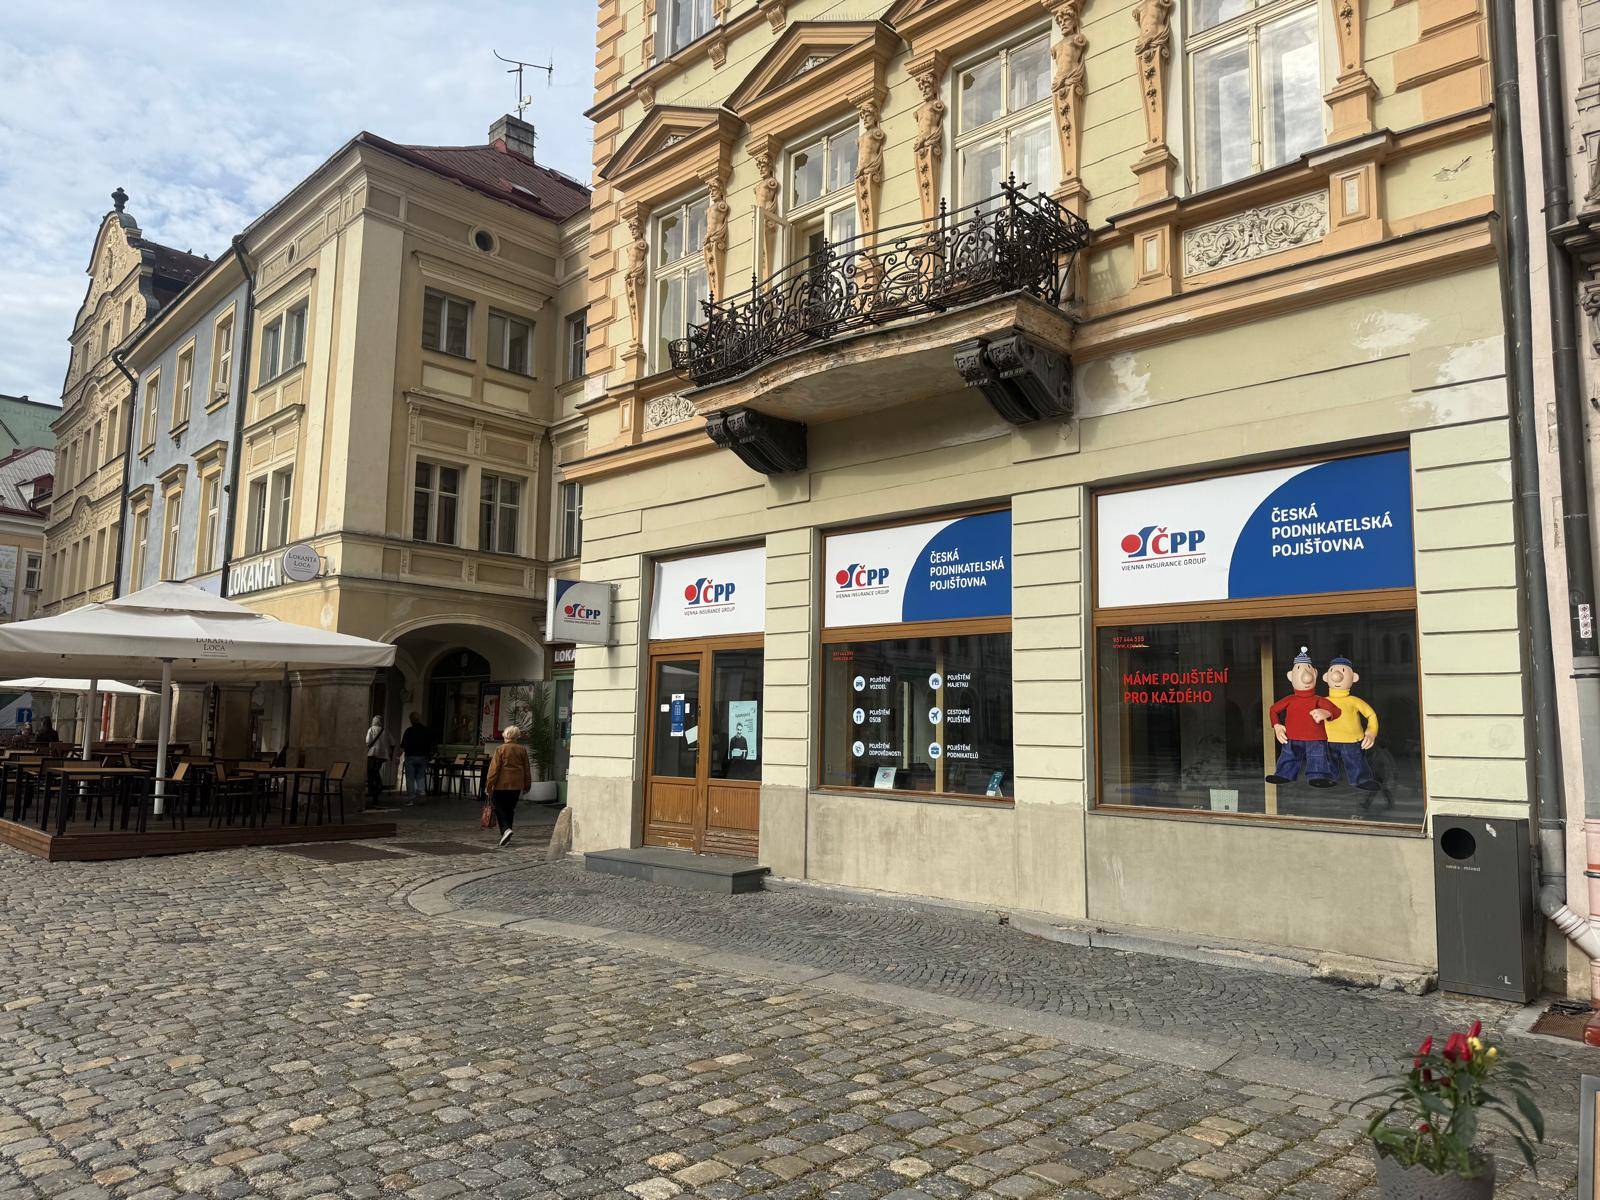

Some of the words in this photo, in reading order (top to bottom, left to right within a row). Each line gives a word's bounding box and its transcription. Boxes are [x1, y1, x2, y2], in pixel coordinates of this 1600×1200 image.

[1271, 503, 1318, 523] ČESKÁ
[1272, 511, 1393, 540] PODNIKATELSKÁ
[1151, 526, 1206, 555] ČPP
[1272, 536, 1364, 558] POJIŠŤOVNA
[930, 548, 959, 564] ČESKÁ
[1146, 560, 1182, 569] INSURANCE
[1183, 557, 1207, 566] GROUP
[855, 564, 890, 587] ČPP
[930, 556, 1005, 577] PODNIKATELSKÁ
[228, 558, 276, 597] LOKANTA
[930, 576, 987, 591] POJIŠŤOVNA
[703, 579, 736, 604] ČPP
[577, 604, 601, 620] ČPP
[203, 643, 226, 651] LOCA
[1123, 670, 1159, 687] MÁME
[1162, 667, 1229, 685] POJIŠTĚNÍ
[1124, 691, 1149, 704] PRO
[1151, 688, 1213, 704] KAŽDÉHO
